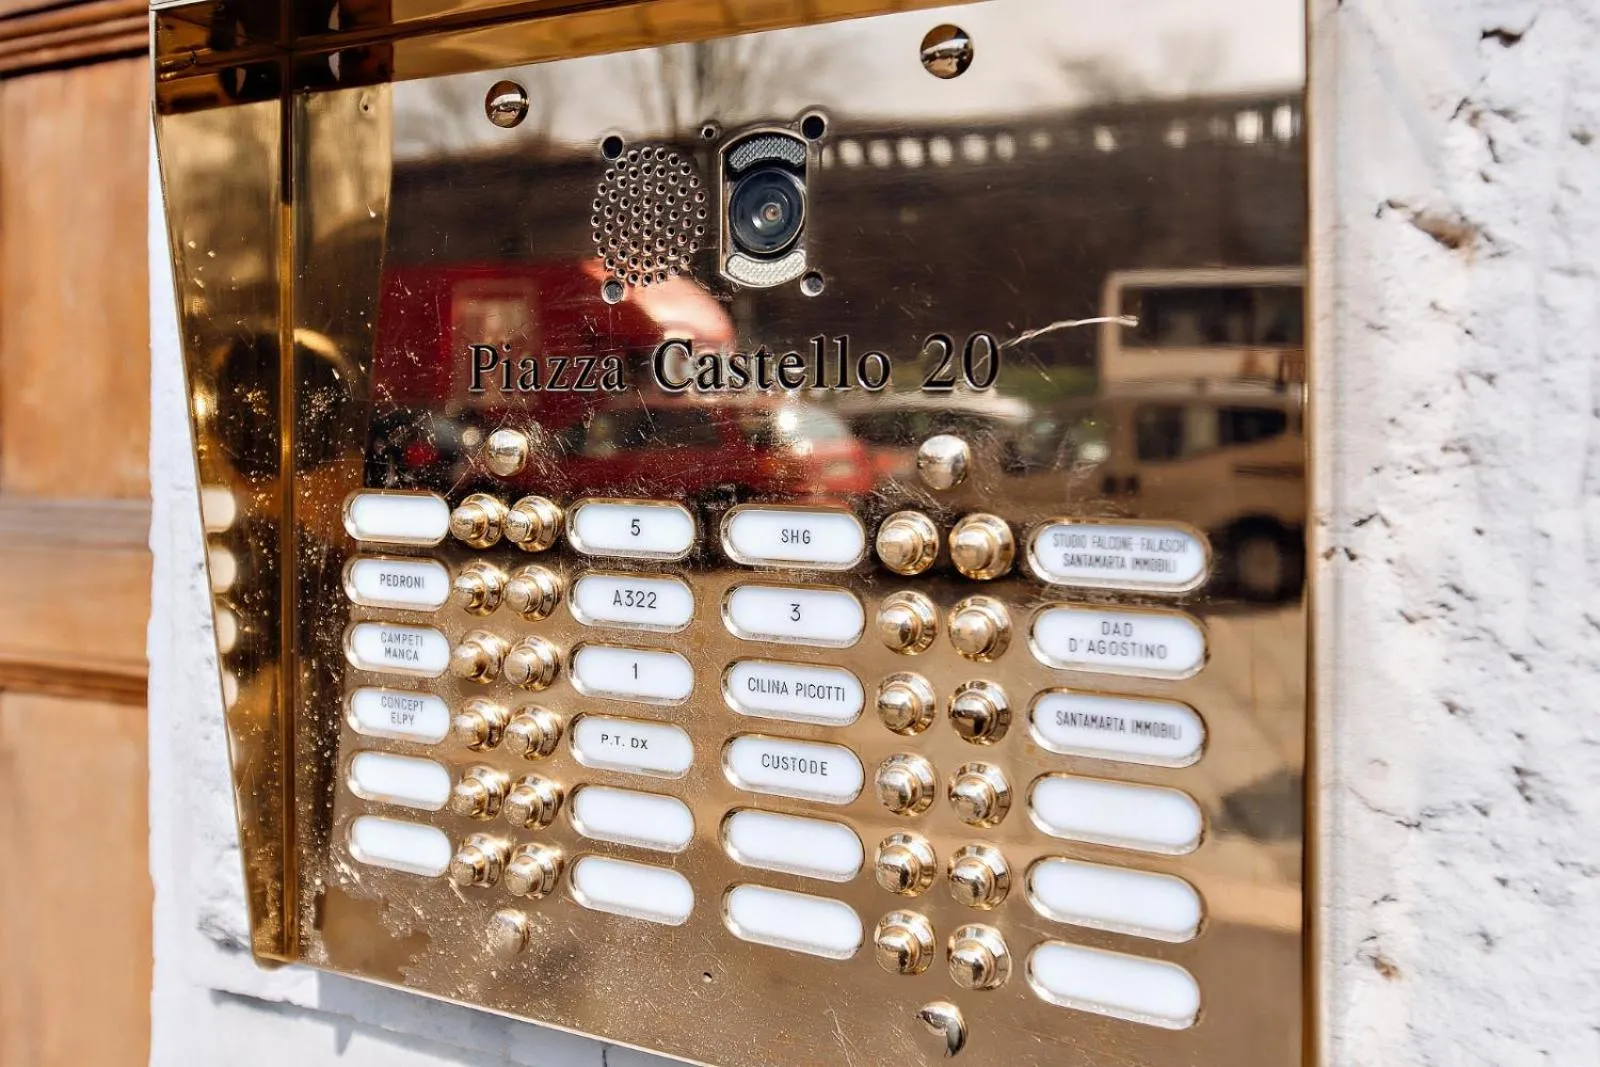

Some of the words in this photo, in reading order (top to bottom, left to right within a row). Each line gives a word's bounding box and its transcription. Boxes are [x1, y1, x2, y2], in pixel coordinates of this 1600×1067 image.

[468, 344, 627, 393] Piazza
[652, 333, 892, 393] Castello
[921, 331, 1000, 393] 20
[630, 518, 641, 537] 5
[781, 528, 812, 545] SHG
[379, 573, 425, 589] PEDRONI
[612, 589, 658, 609] A322
[790, 603, 801, 622] 3
[1101, 621, 1133, 638] DAD
[384, 646, 419, 662] MANCA
[1068, 638, 1168, 660] D'AGOSTINO
[631, 663, 638, 680] 1
[747, 676, 789, 696] CILINA
[795, 682, 846, 702] PICOTTI
[381, 695, 425, 713] CONCEPT
[1055, 709, 1126, 734] SANTAMARTA
[1131, 718, 1183, 741] IMMOBILI
[601, 733, 626, 748] P.T.
[630, 737, 648, 750] DX
[761, 753, 829, 777] CUSTODE
